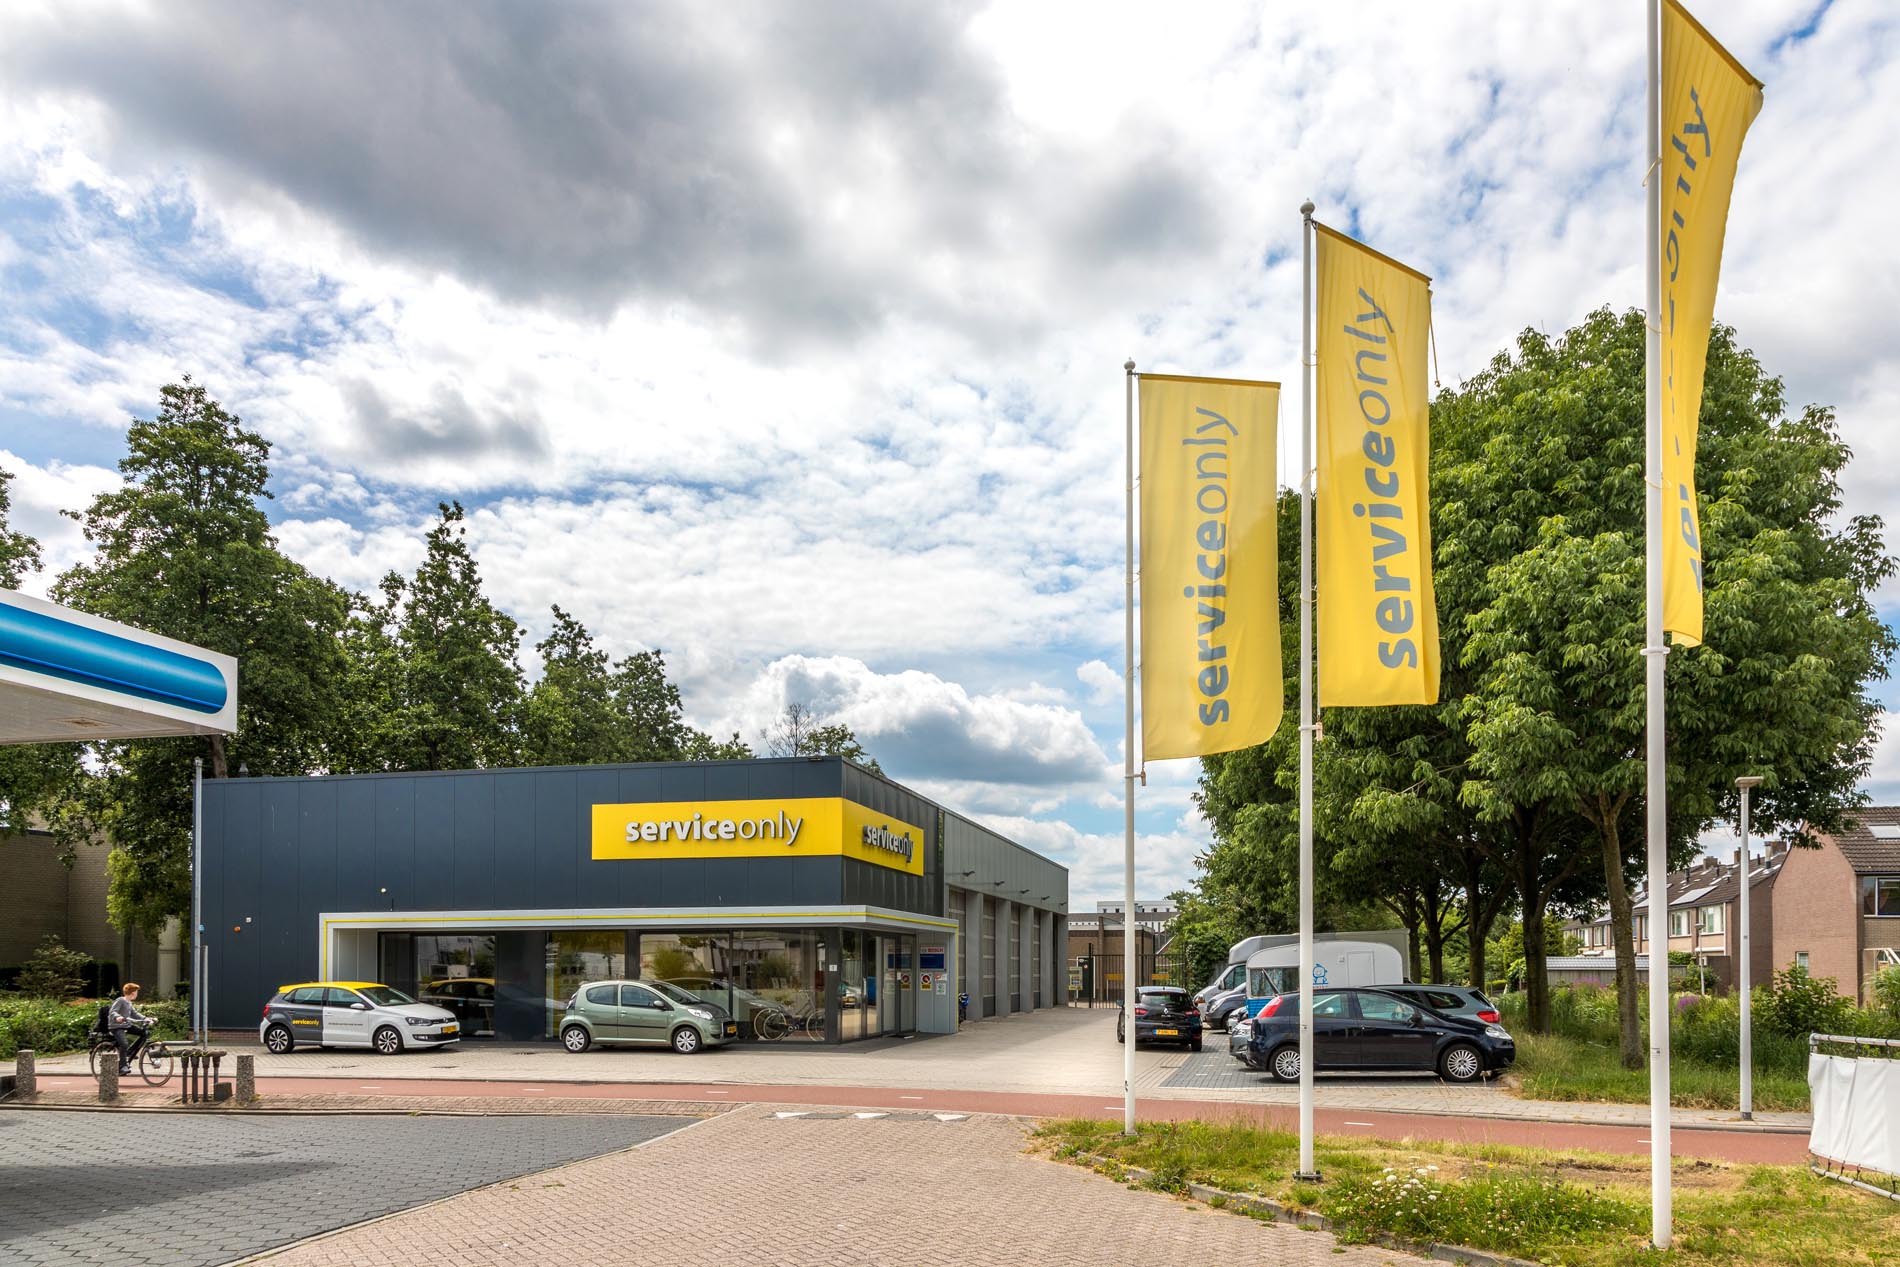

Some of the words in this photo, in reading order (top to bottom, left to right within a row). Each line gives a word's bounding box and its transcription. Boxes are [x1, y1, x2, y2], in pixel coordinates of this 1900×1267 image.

[1344, 287, 1418, 670] serviceonly
[1182, 406, 1239, 727] serviceonly
[625, 810, 804, 846] serviceonly
[863, 824, 914, 864] serviceonly
[292, 1018, 320, 1027] serviceonly
